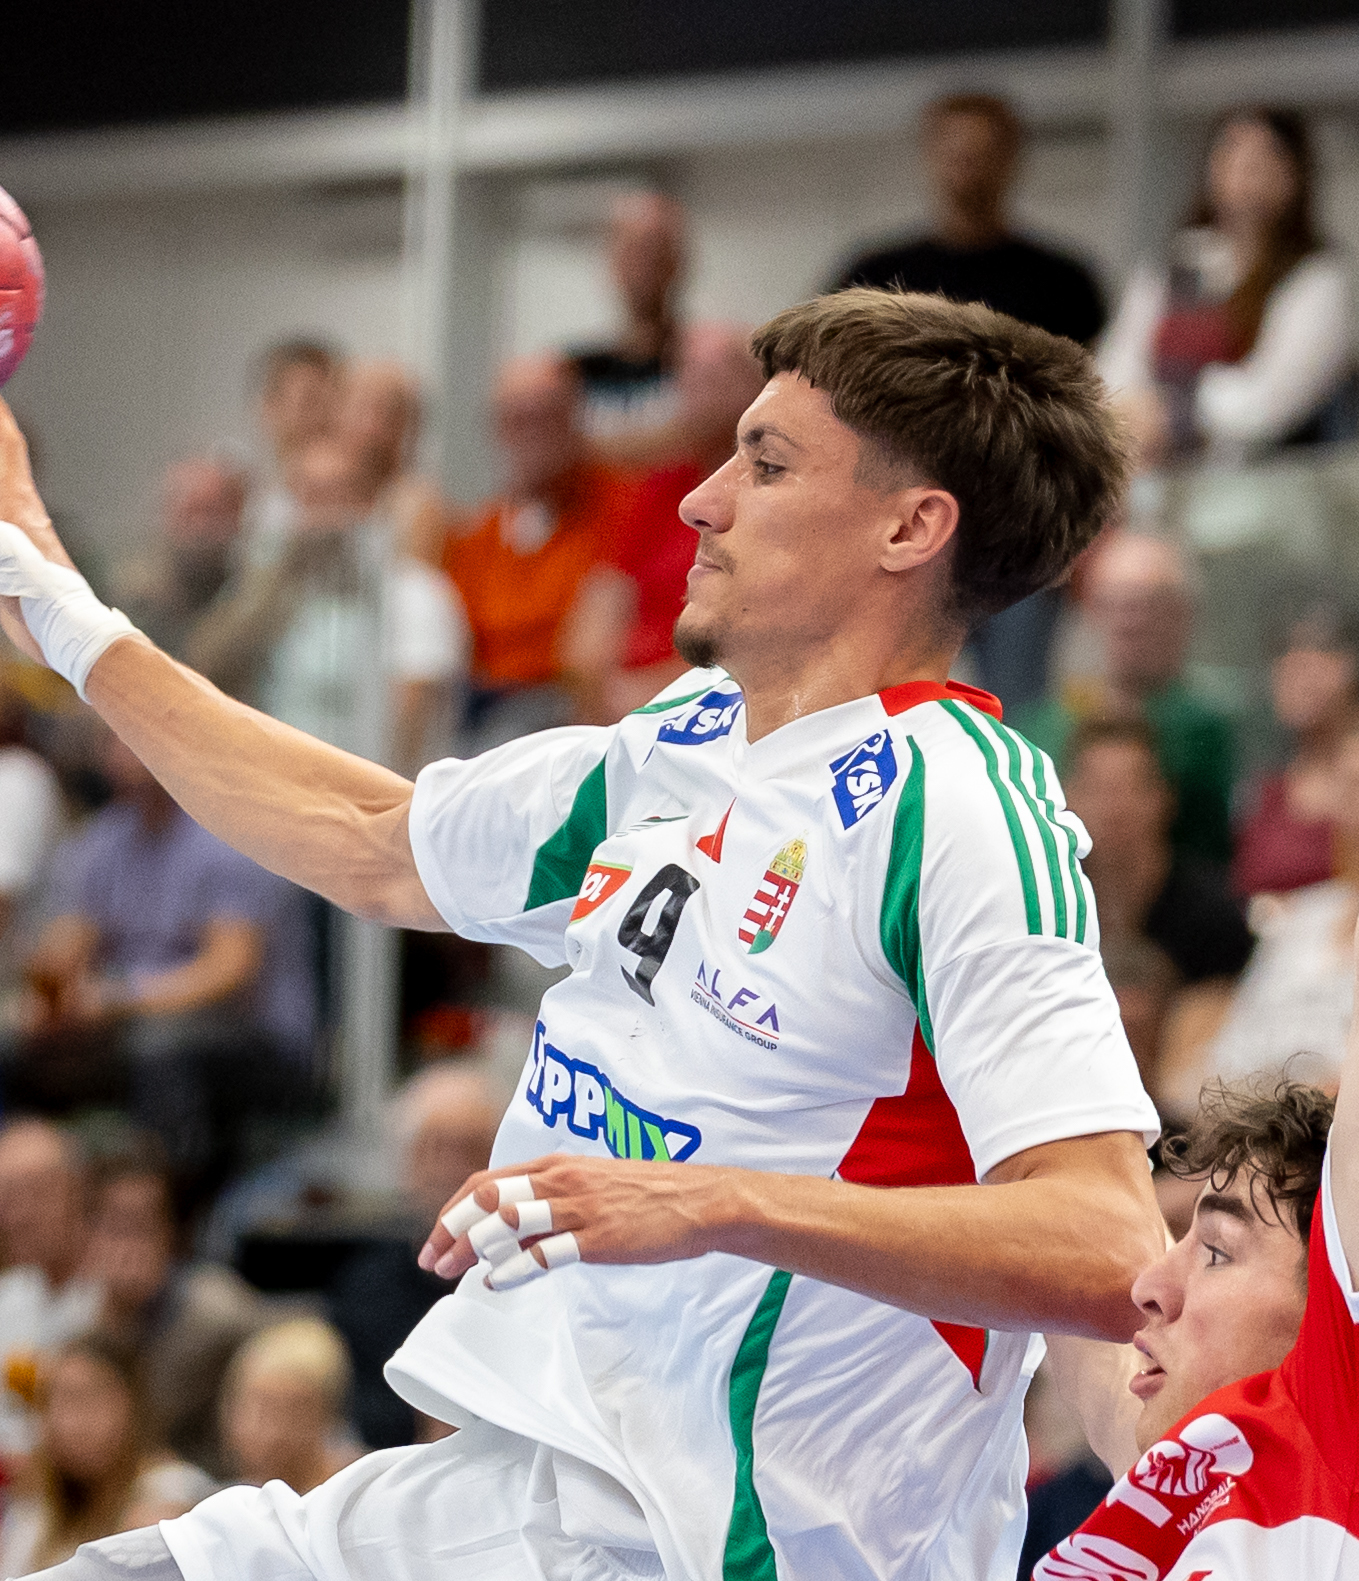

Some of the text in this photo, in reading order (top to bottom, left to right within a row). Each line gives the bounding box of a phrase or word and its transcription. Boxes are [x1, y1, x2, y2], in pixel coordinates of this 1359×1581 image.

[617, 863, 701, 1008] 9
[690, 988, 710, 1013] VIENNA
[745, 1030, 778, 1051] GROUP
[697, 959, 779, 1033] ALFA
